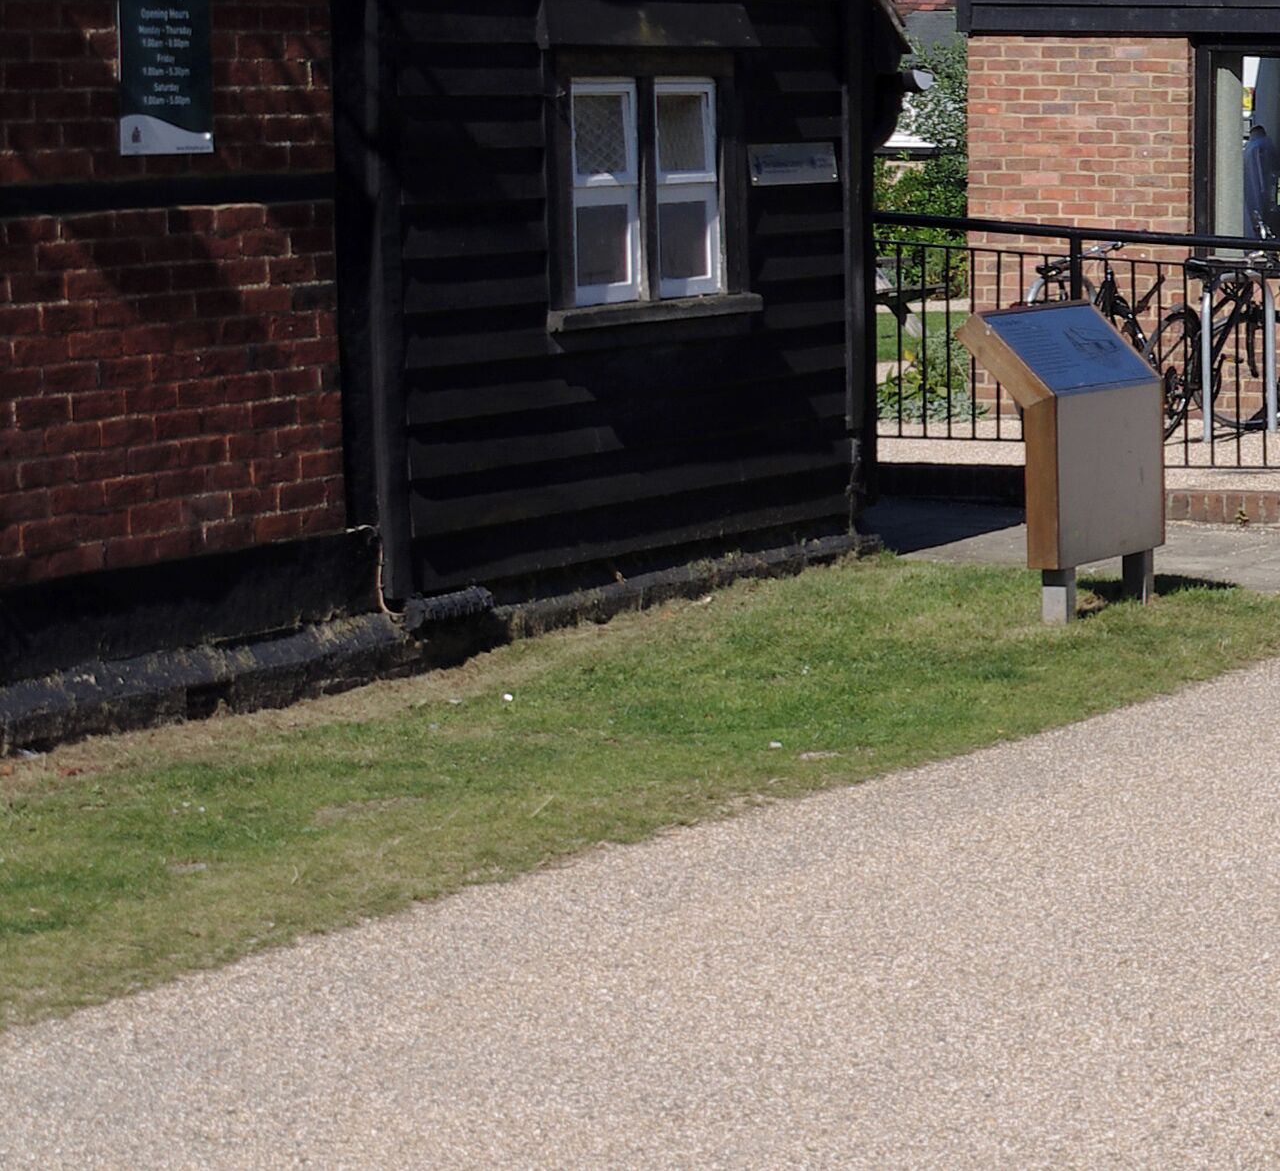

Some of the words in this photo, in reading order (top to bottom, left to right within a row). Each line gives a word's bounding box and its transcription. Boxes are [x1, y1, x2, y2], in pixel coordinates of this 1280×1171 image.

[140, 8, 168, 21] Opening
[169, 8, 189, 19] Hours
[166, 25, 192, 36] Thursday
[156, 53, 175, 64] Friday
[153, 82, 180, 93] Saturday
